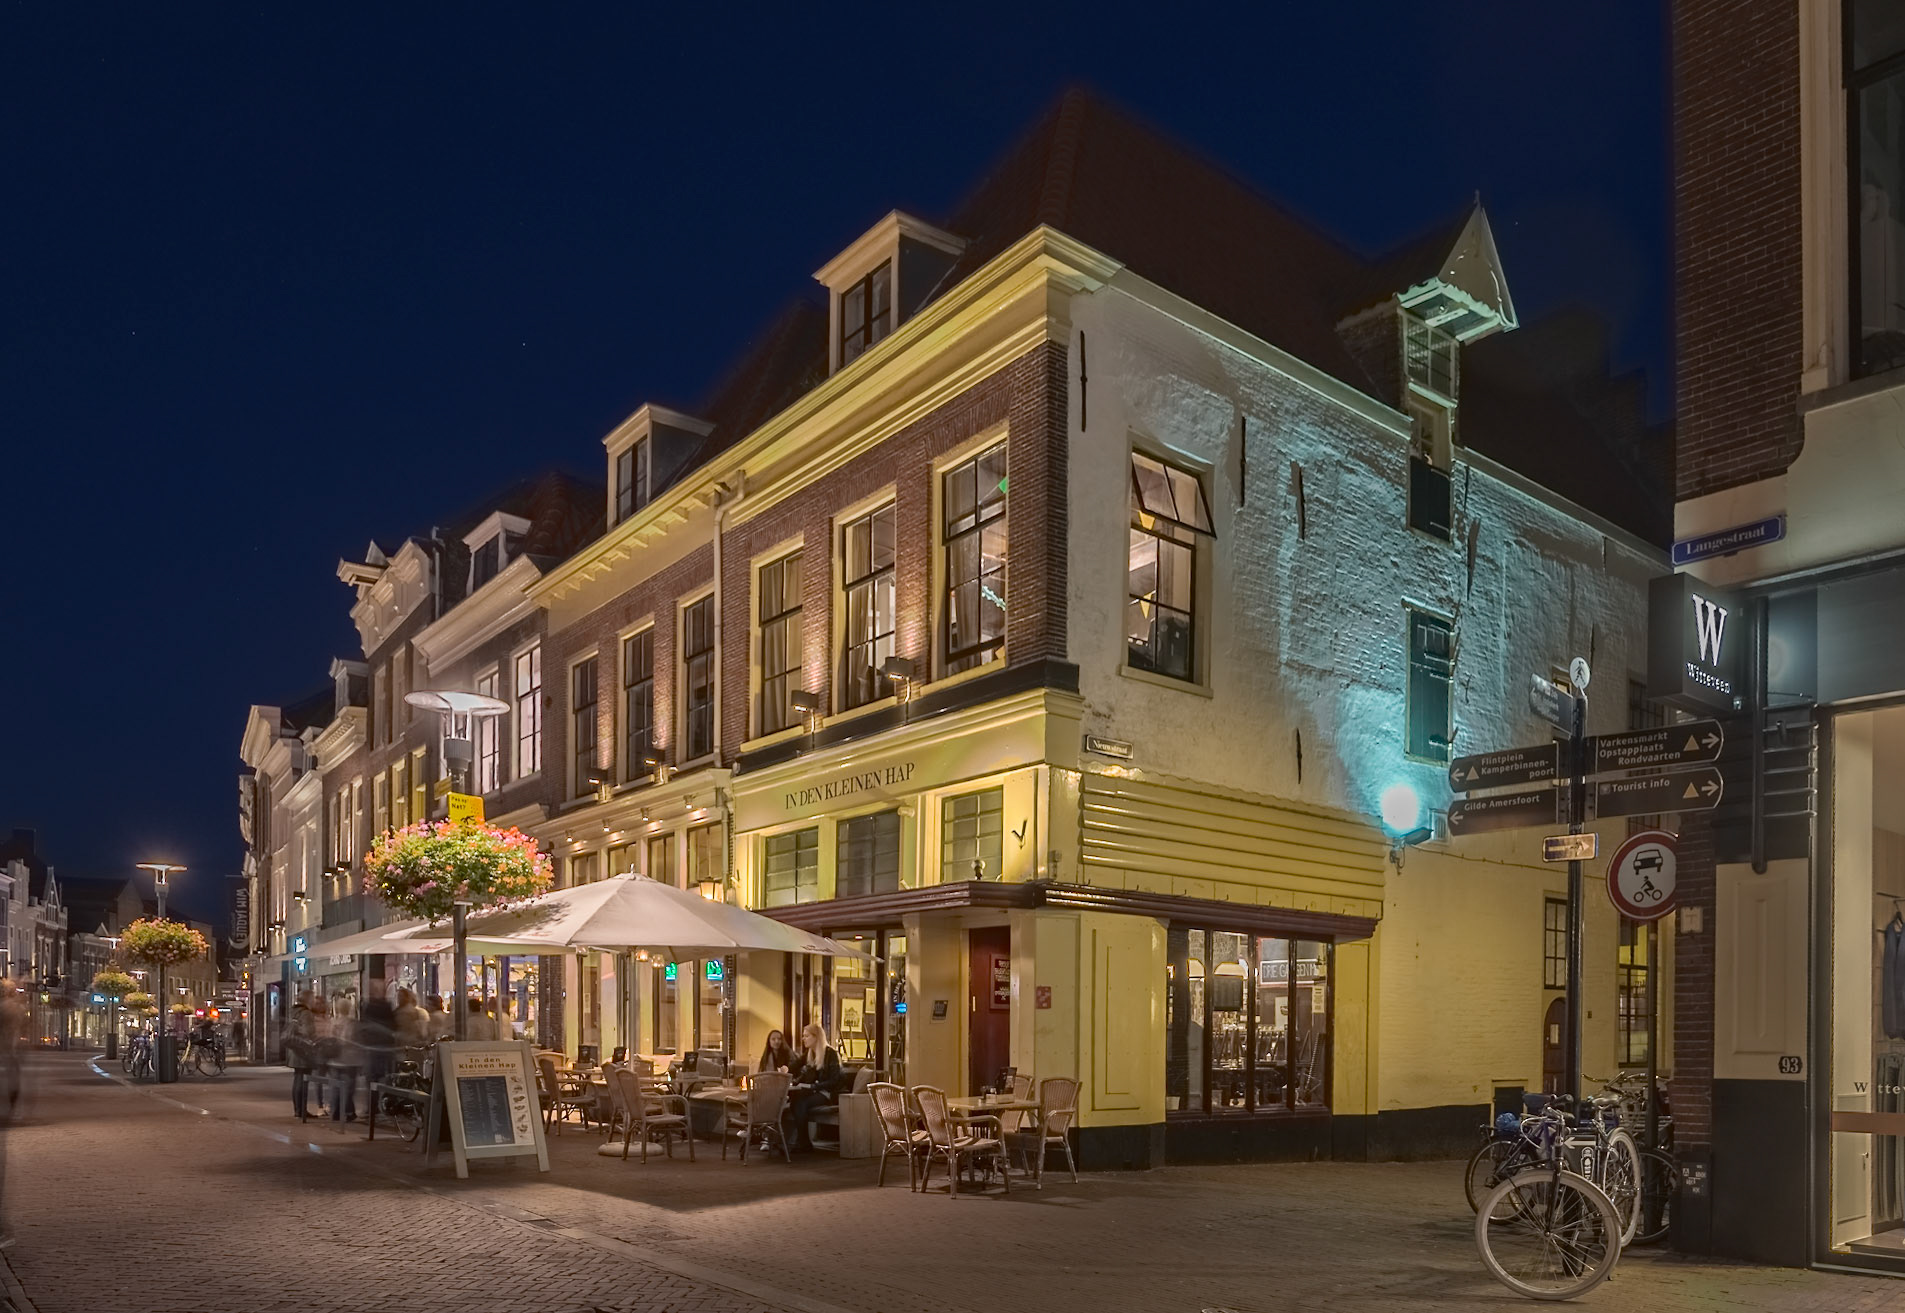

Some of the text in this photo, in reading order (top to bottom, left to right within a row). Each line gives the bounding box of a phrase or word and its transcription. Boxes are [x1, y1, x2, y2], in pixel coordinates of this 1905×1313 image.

[1686, 525, 1766, 555] Langestraat
[1692, 593, 1728, 667] W
[1600, 732, 1668, 748] Varkensmarkt
[1599, 743, 1664, 758] Opstapplaats
[1481, 753, 1524, 766] Flintplein
[1618, 751, 1681, 766] Rondvaarten
[1481, 760, 1549, 775] Kamperbinnen-
[1529, 768, 1554, 779] poort
[785, 762, 915, 809] IN DEN KLEINEN HAP
[1612, 778, 1670, 792] Tourist info
[1464, 795, 1540, 811] Gilde Amersfoort
[1782, 1057, 1799, 1073] 93
[1854, 1081, 1905, 1095] Wtte
